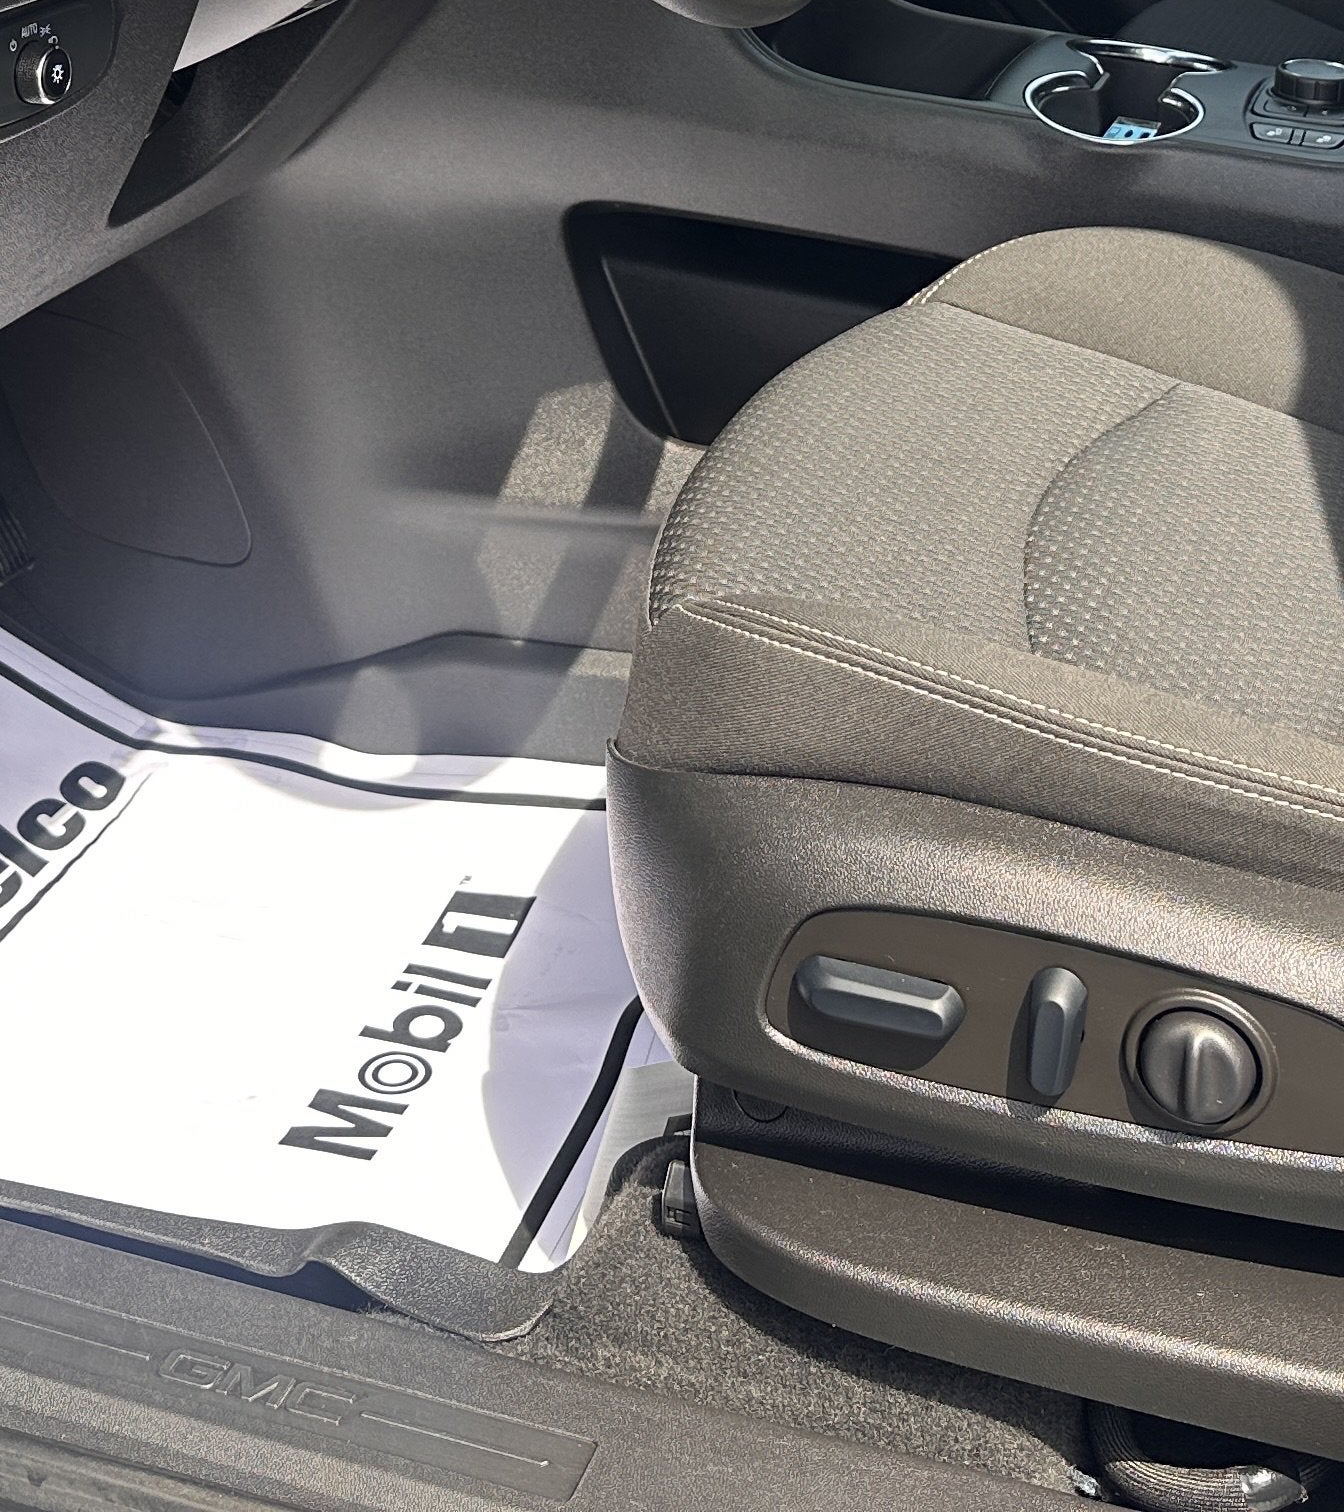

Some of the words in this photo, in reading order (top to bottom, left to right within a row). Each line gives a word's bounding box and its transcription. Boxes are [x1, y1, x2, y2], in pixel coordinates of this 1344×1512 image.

[21, 22, 38, 38] AUTO
[278, 962, 493, 1161] Mobil
[159, 1348, 357, 1426] GMC
